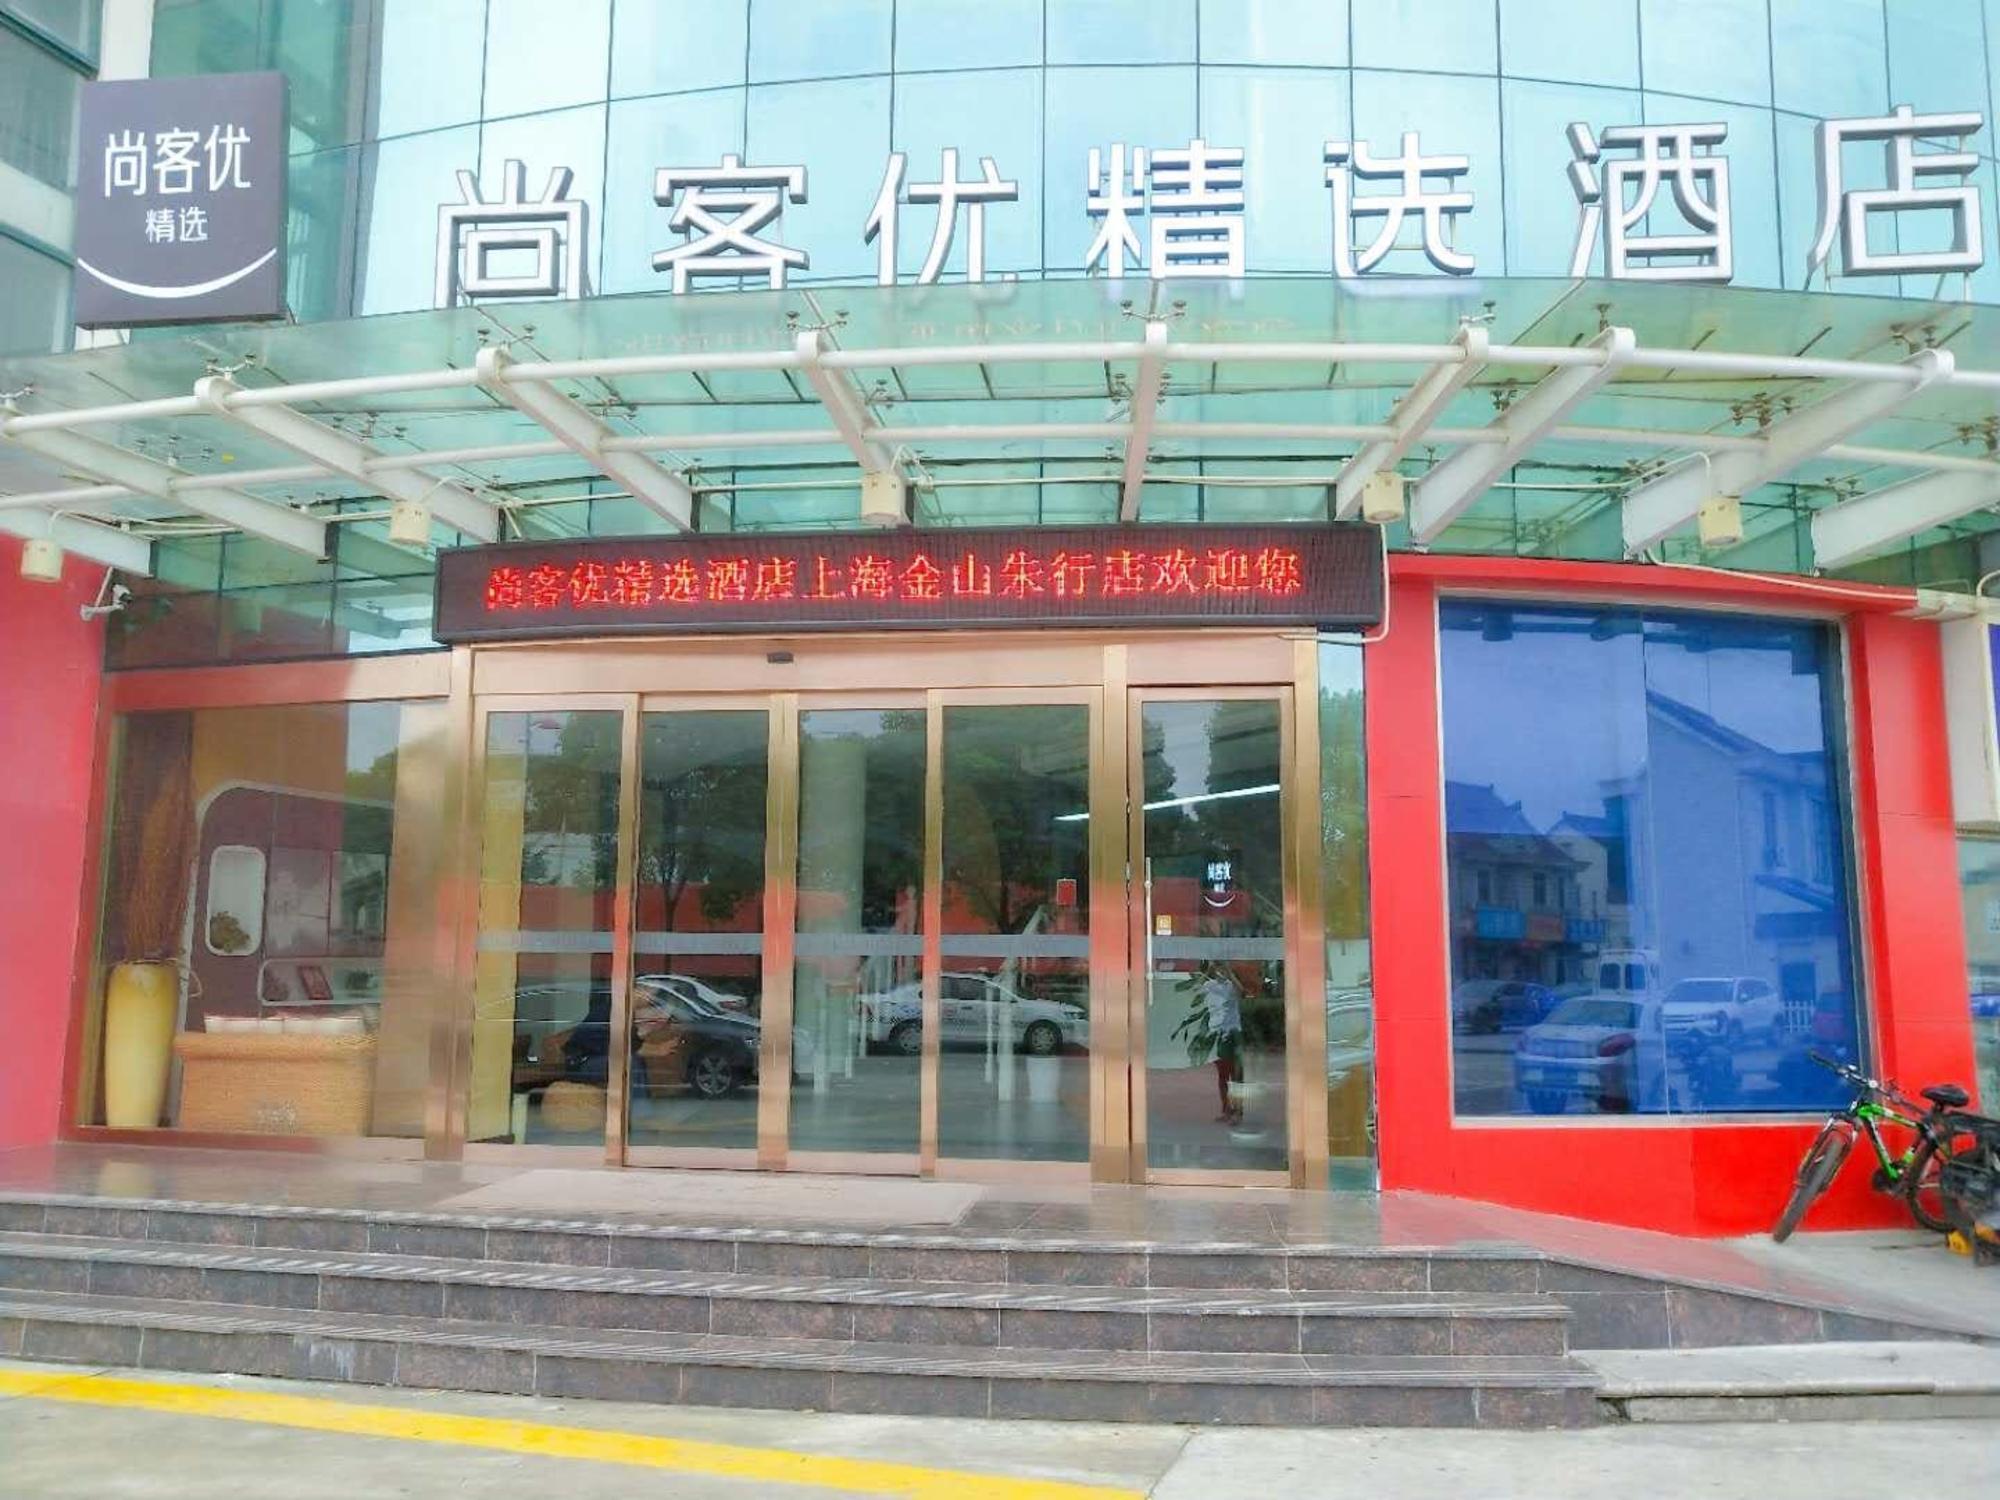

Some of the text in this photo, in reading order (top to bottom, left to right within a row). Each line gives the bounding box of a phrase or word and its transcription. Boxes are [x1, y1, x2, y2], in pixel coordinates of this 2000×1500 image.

[105, 124, 252, 198] 尚客优
[145, 206, 208, 243] 精选
[433, 104, 1985, 309] 尚客优精选酒店
[485, 546, 1302, 611] 尚客优精选酒店上海金山朱行店欢迎您
